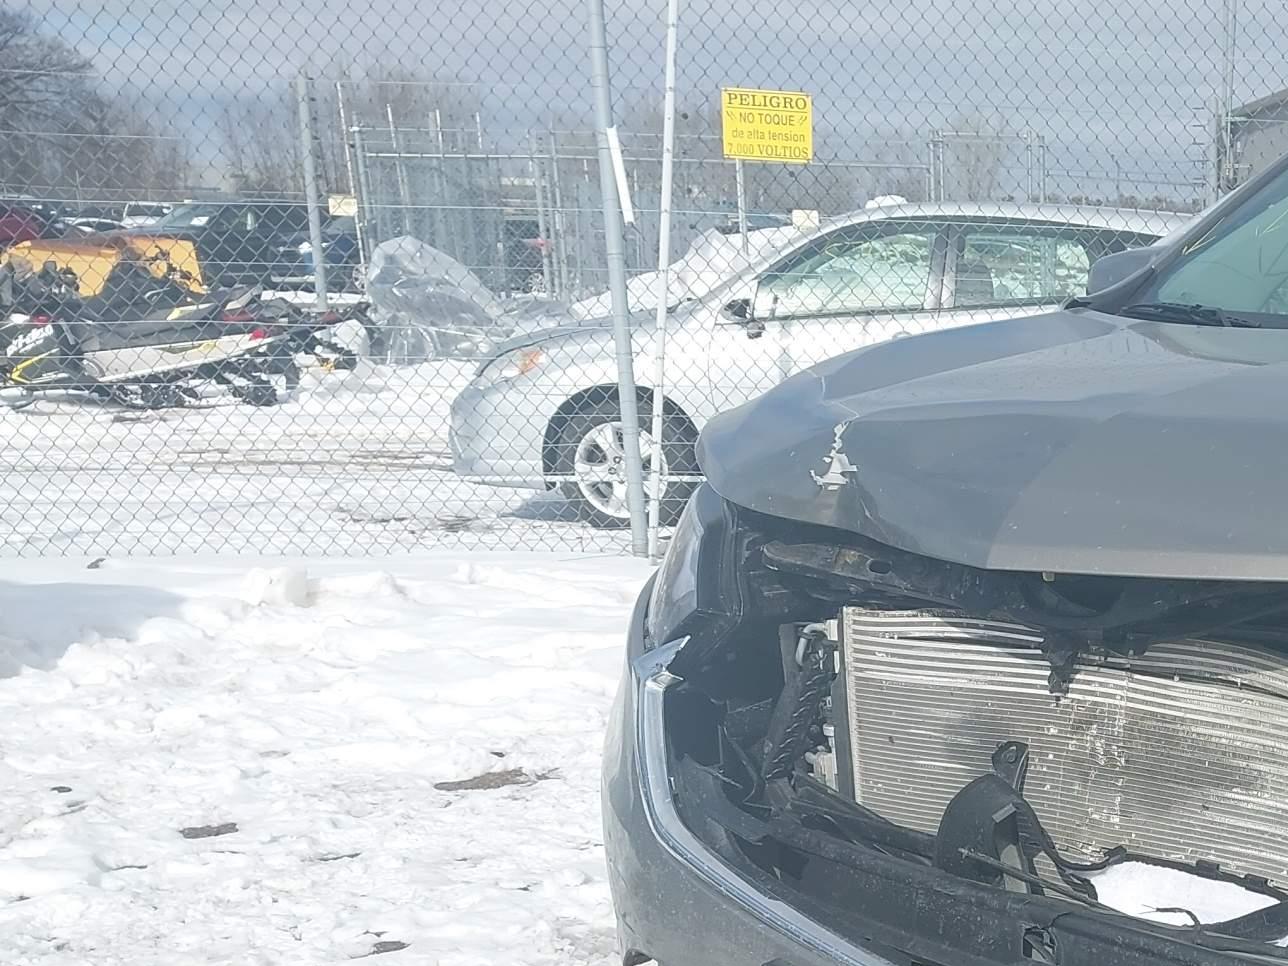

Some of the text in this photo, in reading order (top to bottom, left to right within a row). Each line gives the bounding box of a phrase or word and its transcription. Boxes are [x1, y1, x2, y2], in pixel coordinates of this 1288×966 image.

[727, 92, 807, 110] PELIGRO
[739, 112, 795, 126] NO TOQUE
[731, 128, 744, 138] de
[768, 130, 805, 142] tension
[757, 145, 809, 158] VOLTIOS
